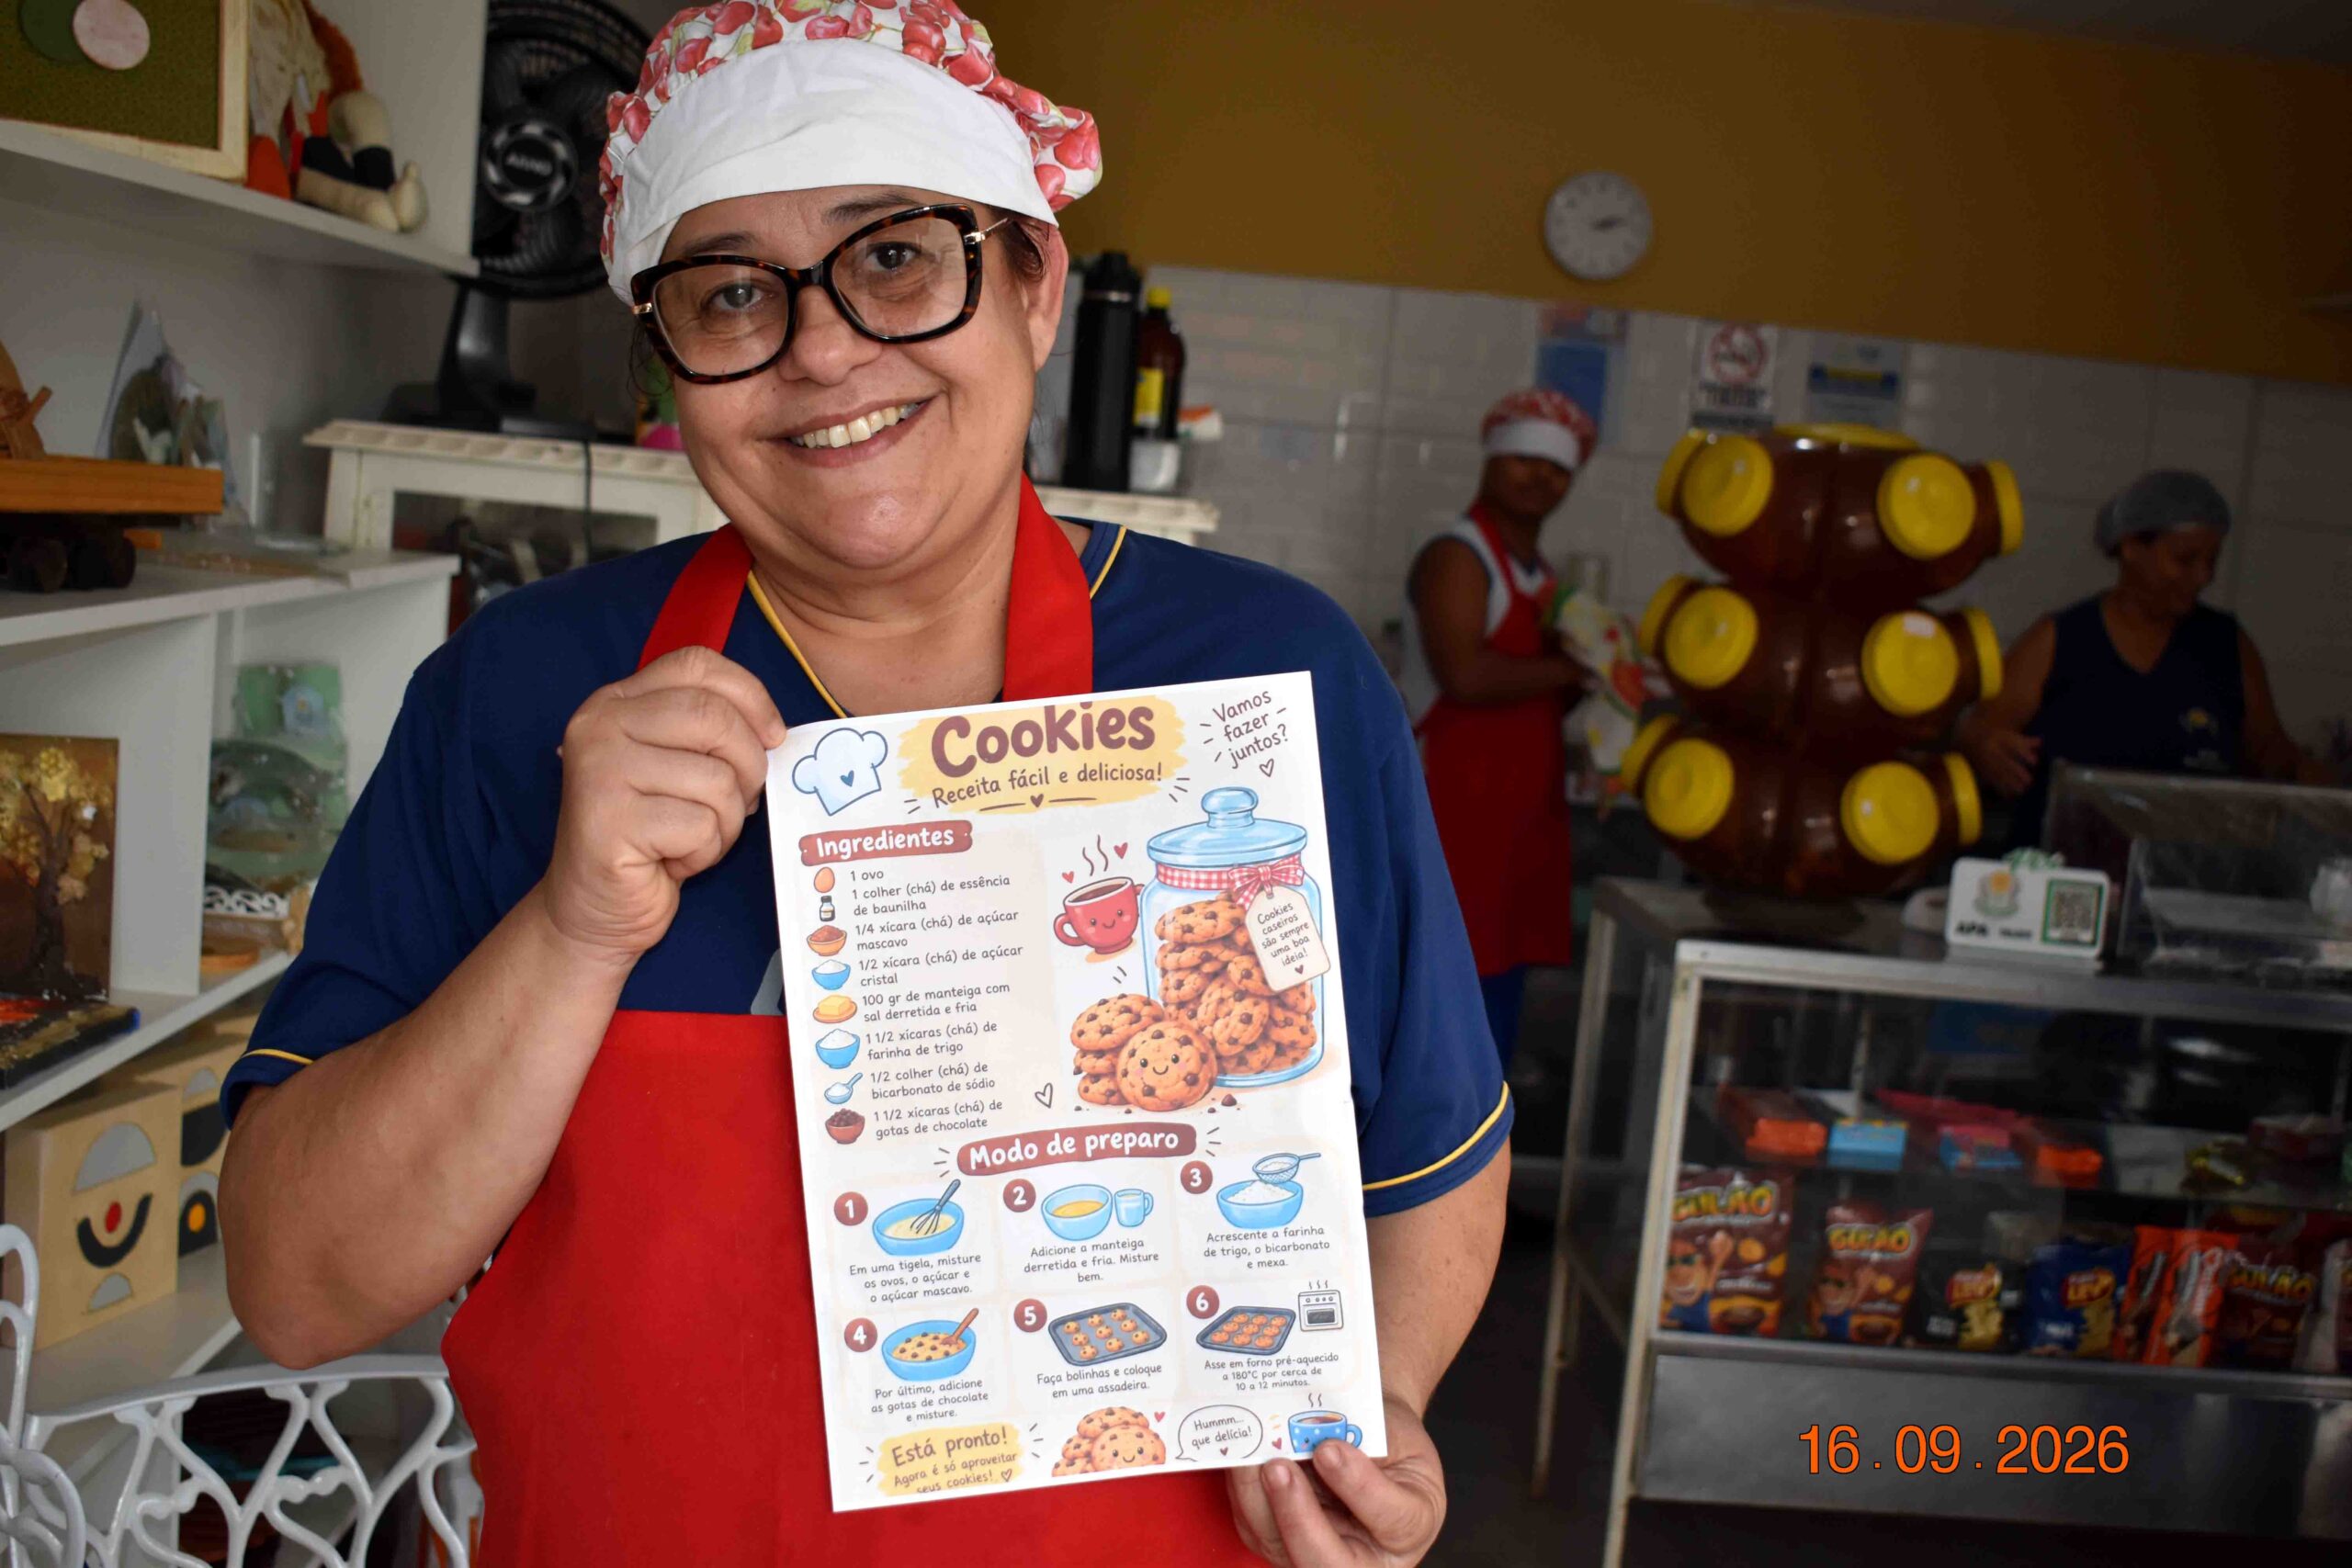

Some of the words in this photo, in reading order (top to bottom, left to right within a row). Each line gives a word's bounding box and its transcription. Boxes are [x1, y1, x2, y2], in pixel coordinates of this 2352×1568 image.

[1212, 691, 1272, 722] Vamos
[1224, 709, 1270, 742] fazer
[932, 701, 1156, 778] Cookies
[1228, 723, 1289, 769] juntos?
[932, 780, 1001, 808] Receita
[1008, 766, 1050, 790] fácil
[1059, 772, 1068, 784] e
[1077, 761, 1161, 782] deliciosa!
[817, 828, 954, 860] Ingredientes
[851, 871, 855, 882] 1
[861, 871, 884, 881] ovo
[853, 889, 857, 899] 1
[863, 886, 901, 899] colher
[906, 881, 936, 897] (chá)
[941, 880, 955, 891] de
[959, 874, 1010, 889] essência
[854, 905, 867, 916] de
[873, 900, 926, 914] baunilha
[1257, 903, 1294, 924] Cookies
[855, 923, 875, 935] 1/4
[879, 921, 917, 933] xícara
[921, 915, 953, 931] (chá)
[957, 914, 972, 925] de
[978, 910, 1019, 925] açúcar
[1262, 914, 1298, 935] caseiros
[857, 939, 908, 951] mascavo
[1261, 938, 1277, 949] são
[1279, 921, 1310, 941] sempre
[1271, 945, 1291, 958] uma
[1292, 936, 1310, 948] boa
[1282, 947, 1307, 966] ideia!
[859, 959, 878, 971] 1/2
[883, 956, 921, 968] xícara
[925, 950, 957, 966] (chá)
[962, 949, 977, 961] de
[981, 945, 1023, 961] açúcar
[860, 973, 898, 987] cristal
[863, 994, 884, 1006] 100
[888, 995, 901, 1007] gr
[906, 990, 920, 1002] de
[924, 985, 982, 1000] manteiga
[986, 985, 1010, 994] com
[864, 1010, 881, 1022] sal
[885, 1005, 941, 1020] derretida
[944, 1006, 951, 1014] e
[956, 1001, 977, 1012] fria
[865, 1033, 871, 1044] 1
[876, 1031, 894, 1043] 1/2
[898, 1026, 942, 1042] xícaras
[946, 1021, 979, 1037] (chá)
[983, 1021, 997, 1032] de
[867, 1047, 911, 1060] farinha
[915, 1044, 930, 1055] de
[933, 1042, 963, 1055] trigo
[871, 1071, 890, 1083] 1/2
[895, 1068, 933, 1080] colher
[938, 1063, 969, 1078] (chá)
[974, 1062, 988, 1073] de
[872, 1083, 943, 1100] bicarbonato
[947, 1080, 961, 1092] de
[966, 1077, 995, 1090] sódio
[874, 1111, 879, 1122] 1
[883, 1109, 902, 1121] 1/2
[908, 1107, 950, 1118] xícaras
[955, 1100, 985, 1115] (chá)
[989, 1100, 1002, 1111] de
[876, 1125, 910, 1141] gotas
[914, 1122, 928, 1134] de
[933, 1118, 988, 1132] chocolate
[970, 1138, 1038, 1170] Modo
[1046, 1134, 1076, 1156] de
[1085, 1132, 1179, 1157] preparo
[1190, 1168, 1202, 1187] 3
[1012, 1186, 1026, 1205] 2
[845, 1199, 854, 1218] 1
[1206, 1230, 1268, 1243] Acrescente
[1283, 1225, 1325, 1237] farinha
[1031, 1246, 1076, 1258] Adicione
[1091, 1238, 1145, 1251] manteiga
[1204, 1247, 1216, 1258] de
[1220, 1247, 1250, 1258] trigo,
[1265, 1240, 1330, 1253] bicarbonato
[850, 1265, 867, 1276] Em
[871, 1264, 895, 1273] uma
[899, 1258, 933, 1273] tigela,
[937, 1255, 981, 1266] misture
[1023, 1258, 1077, 1273] derretida
[1091, 1256, 1115, 1267] fria.
[1120, 1253, 1159, 1263] Misture
[1257, 1259, 1288, 1268] mexa.
[864, 1280, 876, 1289] os
[880, 1277, 908, 1287] ovos,
[922, 1270, 959, 1284] açúcar
[1078, 1272, 1102, 1282] bem.
[881, 1290, 919, 1303] açúcar
[923, 1286, 972, 1297] mascavo.
[1196, 1292, 1209, 1312] 6
[1024, 1305, 1036, 1325] 5
[854, 1325, 866, 1345] 4
[1204, 1359, 1226, 1370] Asse
[1247, 1358, 1273, 1368] forno
[1275, 1352, 1340, 1368] pré-aquecido
[1036, 1373, 1062, 1385] Faça
[1066, 1369, 1110, 1382] bolinhas
[1124, 1364, 1162, 1377] coloque
[1231, 1371, 1258, 1380] 180°C
[1261, 1371, 1277, 1381] por
[1310, 1367, 1321, 1375] de
[875, 1389, 893, 1399] Por
[898, 1385, 935, 1396] último,
[939, 1380, 982, 1392] adicione
[1052, 1390, 1068, 1398] em
[1071, 1387, 1094, 1396] uma
[1098, 1380, 1150, 1394] assadeira.
[1236, 1382, 1246, 1391] 10
[1259, 1381, 1268, 1390] 12
[1272, 1380, 1310, 1388] minutos.
[871, 1404, 883, 1413] as
[888, 1401, 917, 1414] gotas
[921, 1397, 933, 1407] de
[938, 1393, 989, 1405] chocolate
[916, 1410, 957, 1420] misture.
[1193, 1416, 1245, 1432] Hummm...
[891, 1438, 936, 1467] Está
[945, 1426, 1007, 1458] pronto!
[1192, 1437, 1211, 1450] que
[1215, 1426, 1253, 1443] delícia!
[894, 1471, 927, 1488] Agora
[933, 1464, 939, 1475] é
[944, 1460, 956, 1473] só
[961, 1453, 1017, 1472] aproveitar
[946, 1469, 992, 1488] cookies!
